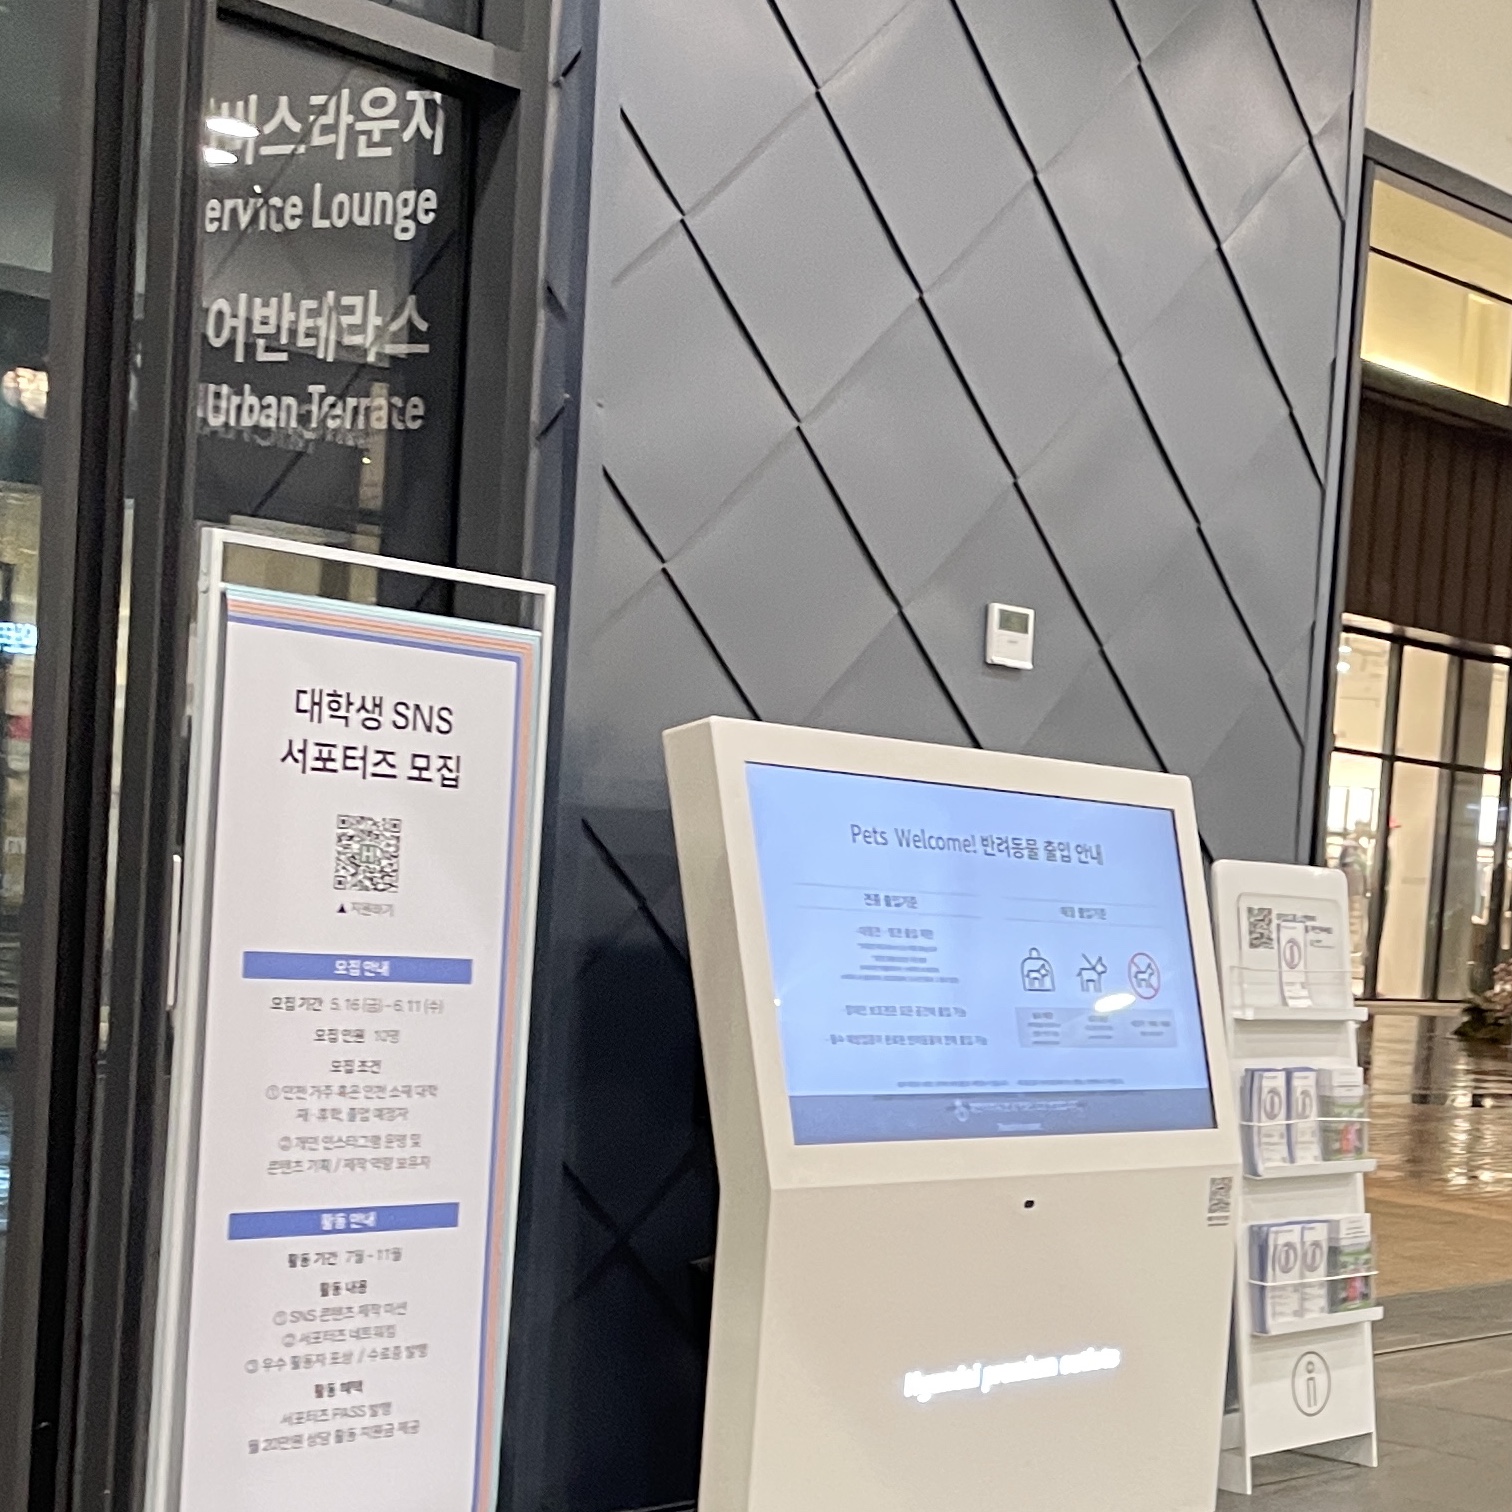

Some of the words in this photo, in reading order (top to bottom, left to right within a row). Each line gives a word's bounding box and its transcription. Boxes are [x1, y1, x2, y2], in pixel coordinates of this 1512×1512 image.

[312, 182, 437, 241] Lounge
[206, 290, 430, 363] 어반테라스
[206, 383, 299, 428] Urban
[307, 384, 426, 430] Terrace
[295, 688, 383, 731] 대학생
[392, 701, 454, 735] SNS
[280, 739, 398, 780] 서포터즈
[407, 753, 461, 789] 모집
[850, 824, 888, 846] Pets
[893, 828, 977, 854] Welcome!
[980, 834, 1039, 861] 반려동물
[1074, 843, 1104, 865] 안내
